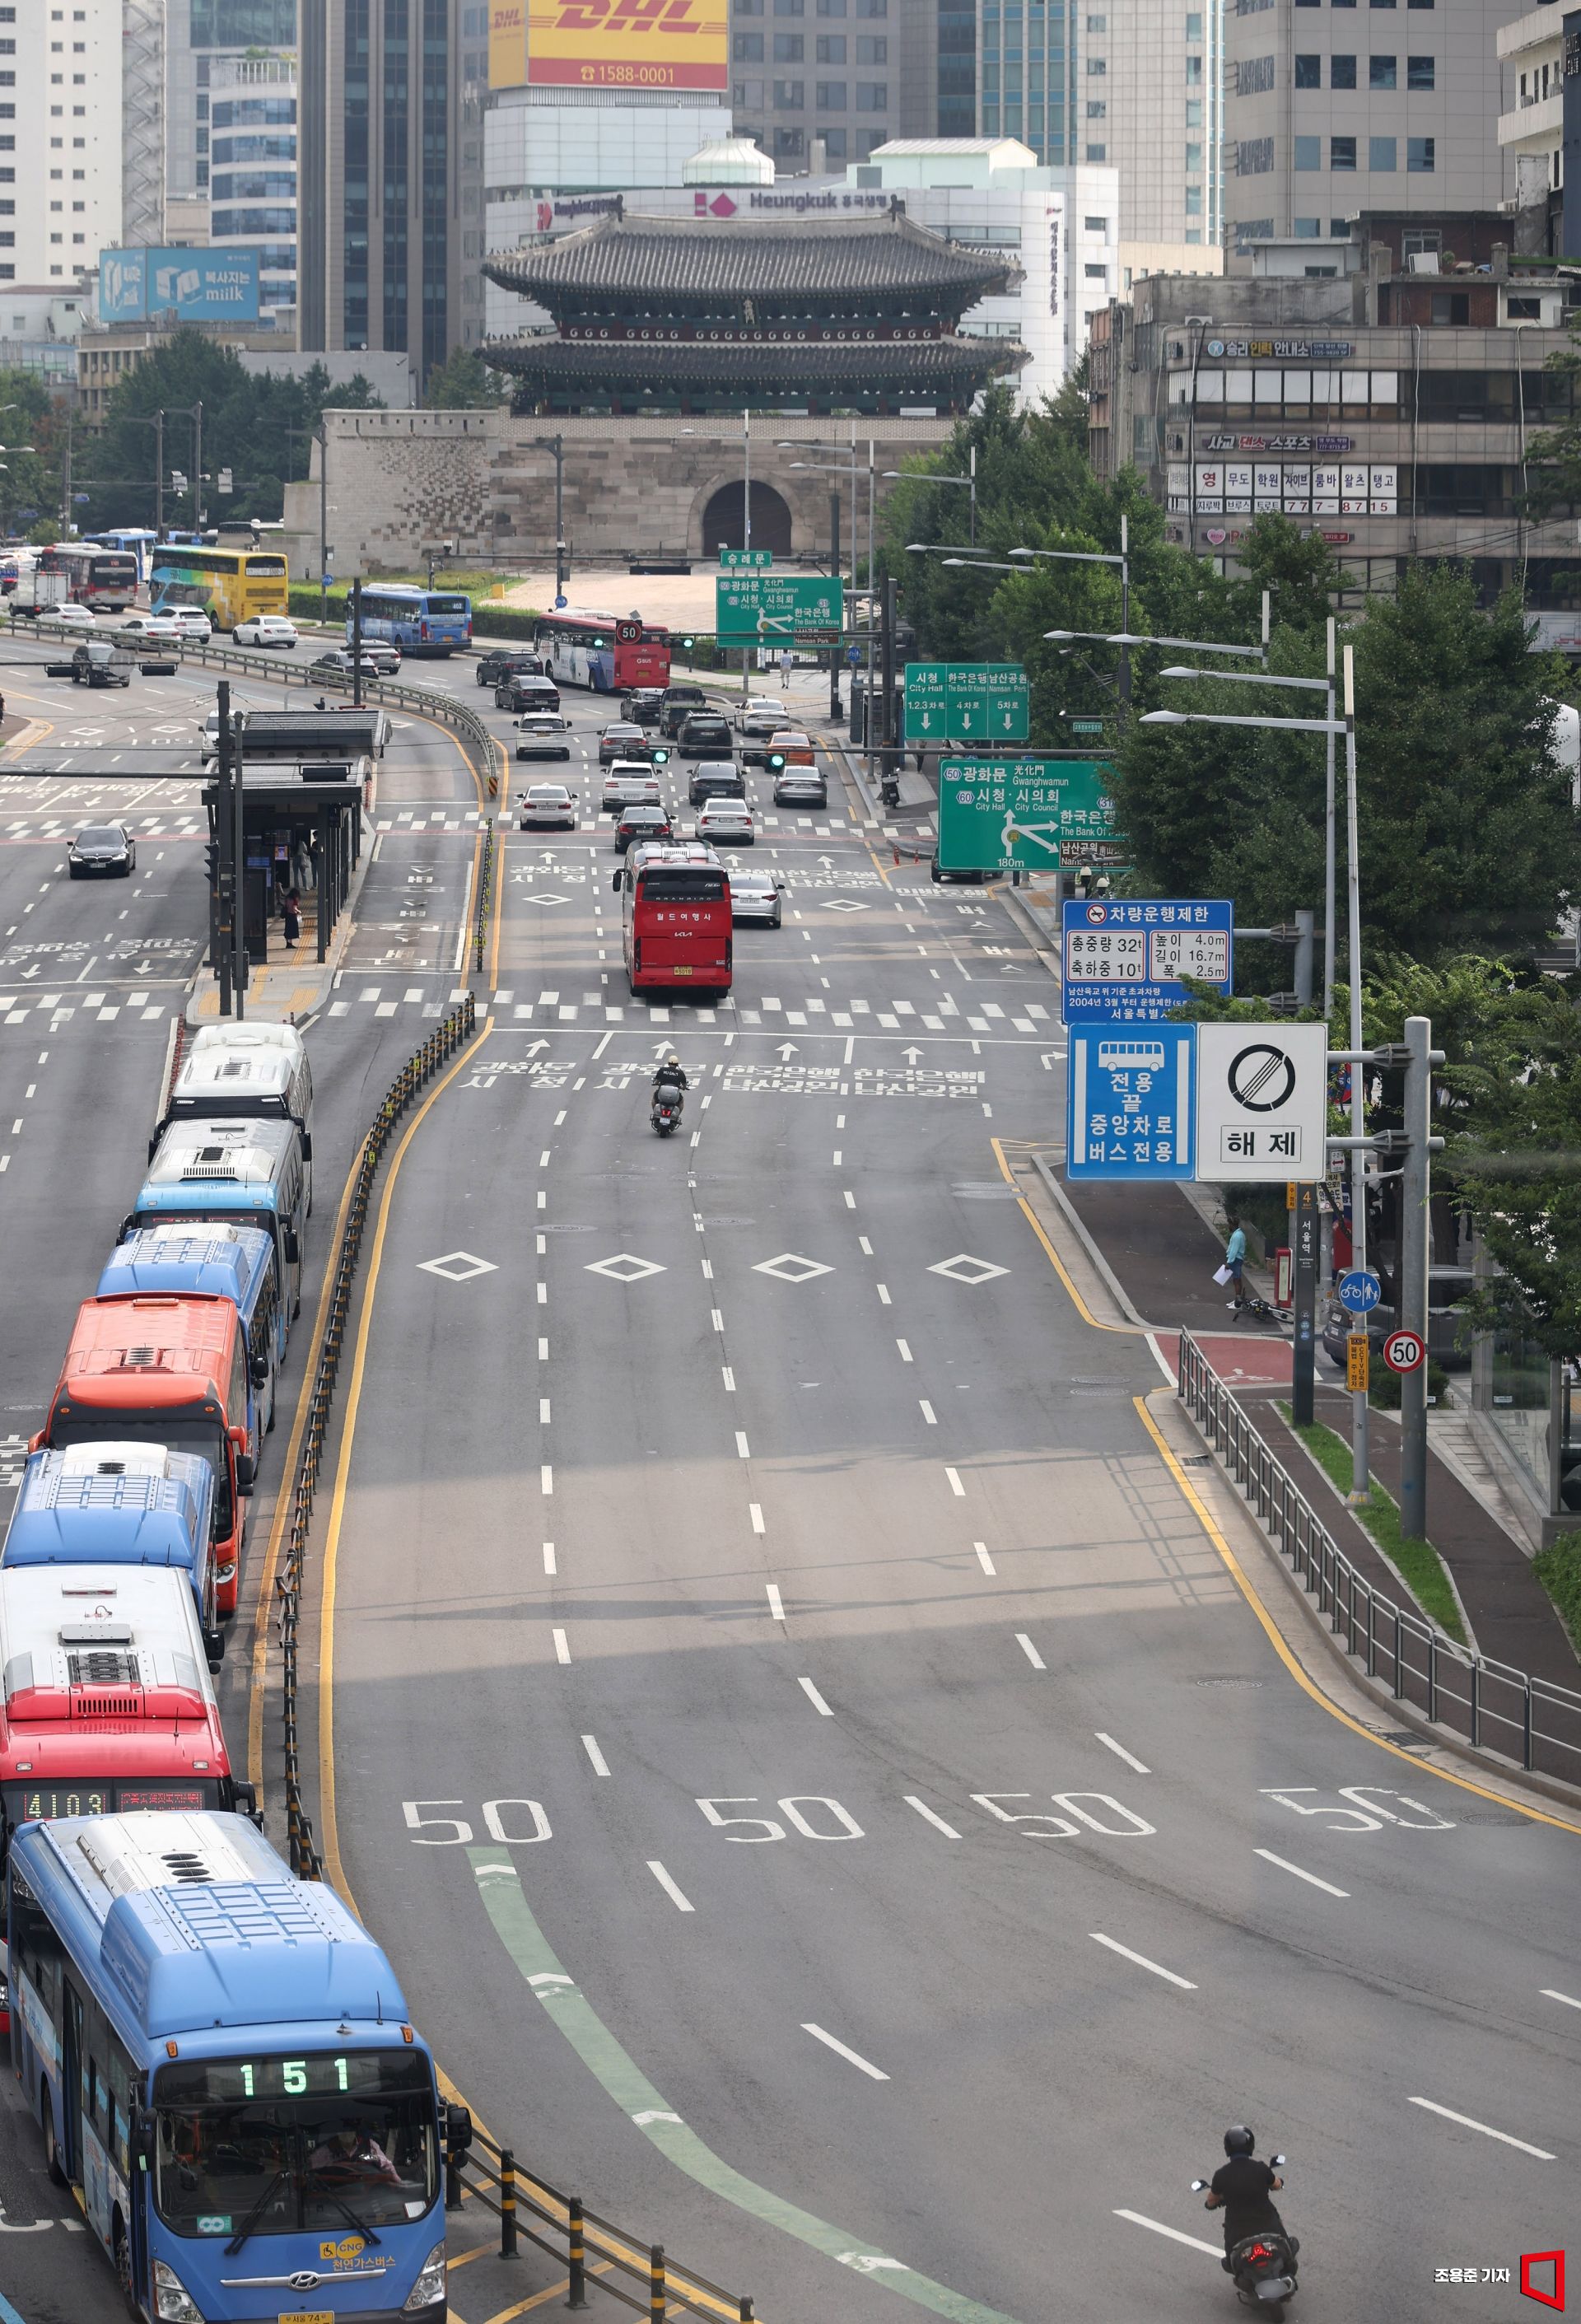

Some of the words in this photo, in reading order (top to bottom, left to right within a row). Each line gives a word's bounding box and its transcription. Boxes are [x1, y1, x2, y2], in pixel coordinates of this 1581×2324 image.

[555, 0, 702, 33] DHL
[599, 65, 674, 83] 1588-0001
[750, 192, 837, 212] Heungkuk
[1226, 341, 1249, 357] 승리
[1250, 341, 1273, 357] 인력
[1274, 341, 1309, 357] 안내소
[1208, 435, 1236, 450] 사교
[1238, 435, 1266, 451] 댄스
[1269, 435, 1312, 450] 스포츠
[1202, 472, 1216, 488] 영
[1227, 472, 1250, 487] 무도
[1257, 472, 1279, 488] 학원
[1285, 472, 1308, 488] 자이브
[1315, 473, 1336, 488] 룸바
[1344, 473, 1365, 488] 왈츠
[1373, 474, 1394, 488] 탱고
[1227, 499, 1251, 511] 브루스
[727, 553, 765, 564] 숭례문
[731, 581, 759, 591] 광화문
[795, 608, 830, 618] 한국은행
[623, 628, 636, 638] 50
[916, 672, 937, 684] 시청
[948, 672, 987, 684] 한국은행
[989, 672, 1028, 684] 남산공원
[909, 684, 926, 693] City
[928, 684, 943, 693] Hall
[948, 684, 957, 693] The
[957, 684, 968, 693] Bank
[968, 684, 973, 693] Of
[973, 684, 986, 693] Korea
[989, 684, 1011, 693] Namsan
[1014, 684, 1027, 693] Park
[997, 701, 1019, 710] 5차로
[947, 769, 959, 778] 50
[963, 767, 1008, 782] 광화문
[1014, 764, 1045, 776] 光化門
[1012, 776, 1069, 787] Gwanghwamun
[959, 793, 971, 802] 60
[976, 802, 990, 812] City
[991, 803, 1005, 811] Hall
[1014, 803, 1029, 813] City
[1033, 803, 1059, 812] Council
[1060, 810, 1115, 825] 한국은행
[1061, 827, 1075, 836] The
[1076, 827, 1094, 837] Bank
[1096, 827, 1106, 836] Of
[1061, 842, 1098, 856] 남산공원
[997, 859, 1024, 868] 180m
[656, 912, 711, 922] 월드여행사
[1110, 906, 1209, 922] 차량운행제한
[1072, 936, 1112, 952] 총중량
[1117, 939, 1142, 953] 32t
[1155, 933, 1181, 947] 높이
[1195, 934, 1224, 945] 4.0m
[1154, 950, 1181, 963] 길이
[1188, 950, 1224, 962] 16.7m
[1071, 959, 1111, 977] 축하중
[1117, 963, 1141, 978] 10t
[1163, 964, 1175, 978] 폭
[1196, 965, 1224, 978] 2.5m
[1068, 987, 1100, 996] 남산육교
[1102, 987, 1109, 996] 위
[1129, 987, 1161, 996] 초과차량
[1069, 998, 1102, 1006] 2004년
[1104, 998, 1118, 1006] 3월
[1121, 998, 1137, 1006] 부터
[1140, 998, 1172, 1006] 운행제한
[470, 1062, 577, 1075] 광화문
[725, 1064, 842, 1080] 한국은행
[853, 1068, 978, 1084] 한국은행
[1110, 1071, 1153, 1094] 전용
[722, 1078, 838, 1095] 남산공원
[854, 1082, 978, 1099] 남산공원
[1121, 1094, 1142, 1113] 끝
[1089, 1113, 1173, 1136] 중앙차로
[1227, 1131, 1295, 1156] 해제
[1303, 1191, 1311, 1203] 4
[1302, 1220, 1311, 1253] 서울역
[1392, 1342, 1416, 1363] 50
[28, 1794, 103, 1818] 4103
[1257, 1786, 1457, 1832] 50
[695, 1795, 866, 1843] 50
[969, 1792, 1157, 1838] 50
[402, 1799, 553, 1846] 50
[240, 2058, 348, 2097] 151
[339, 2243, 363, 2252] CNG
[332, 2255, 397, 2271] 천연가스버스
[309, 2314, 320, 2322] 74
